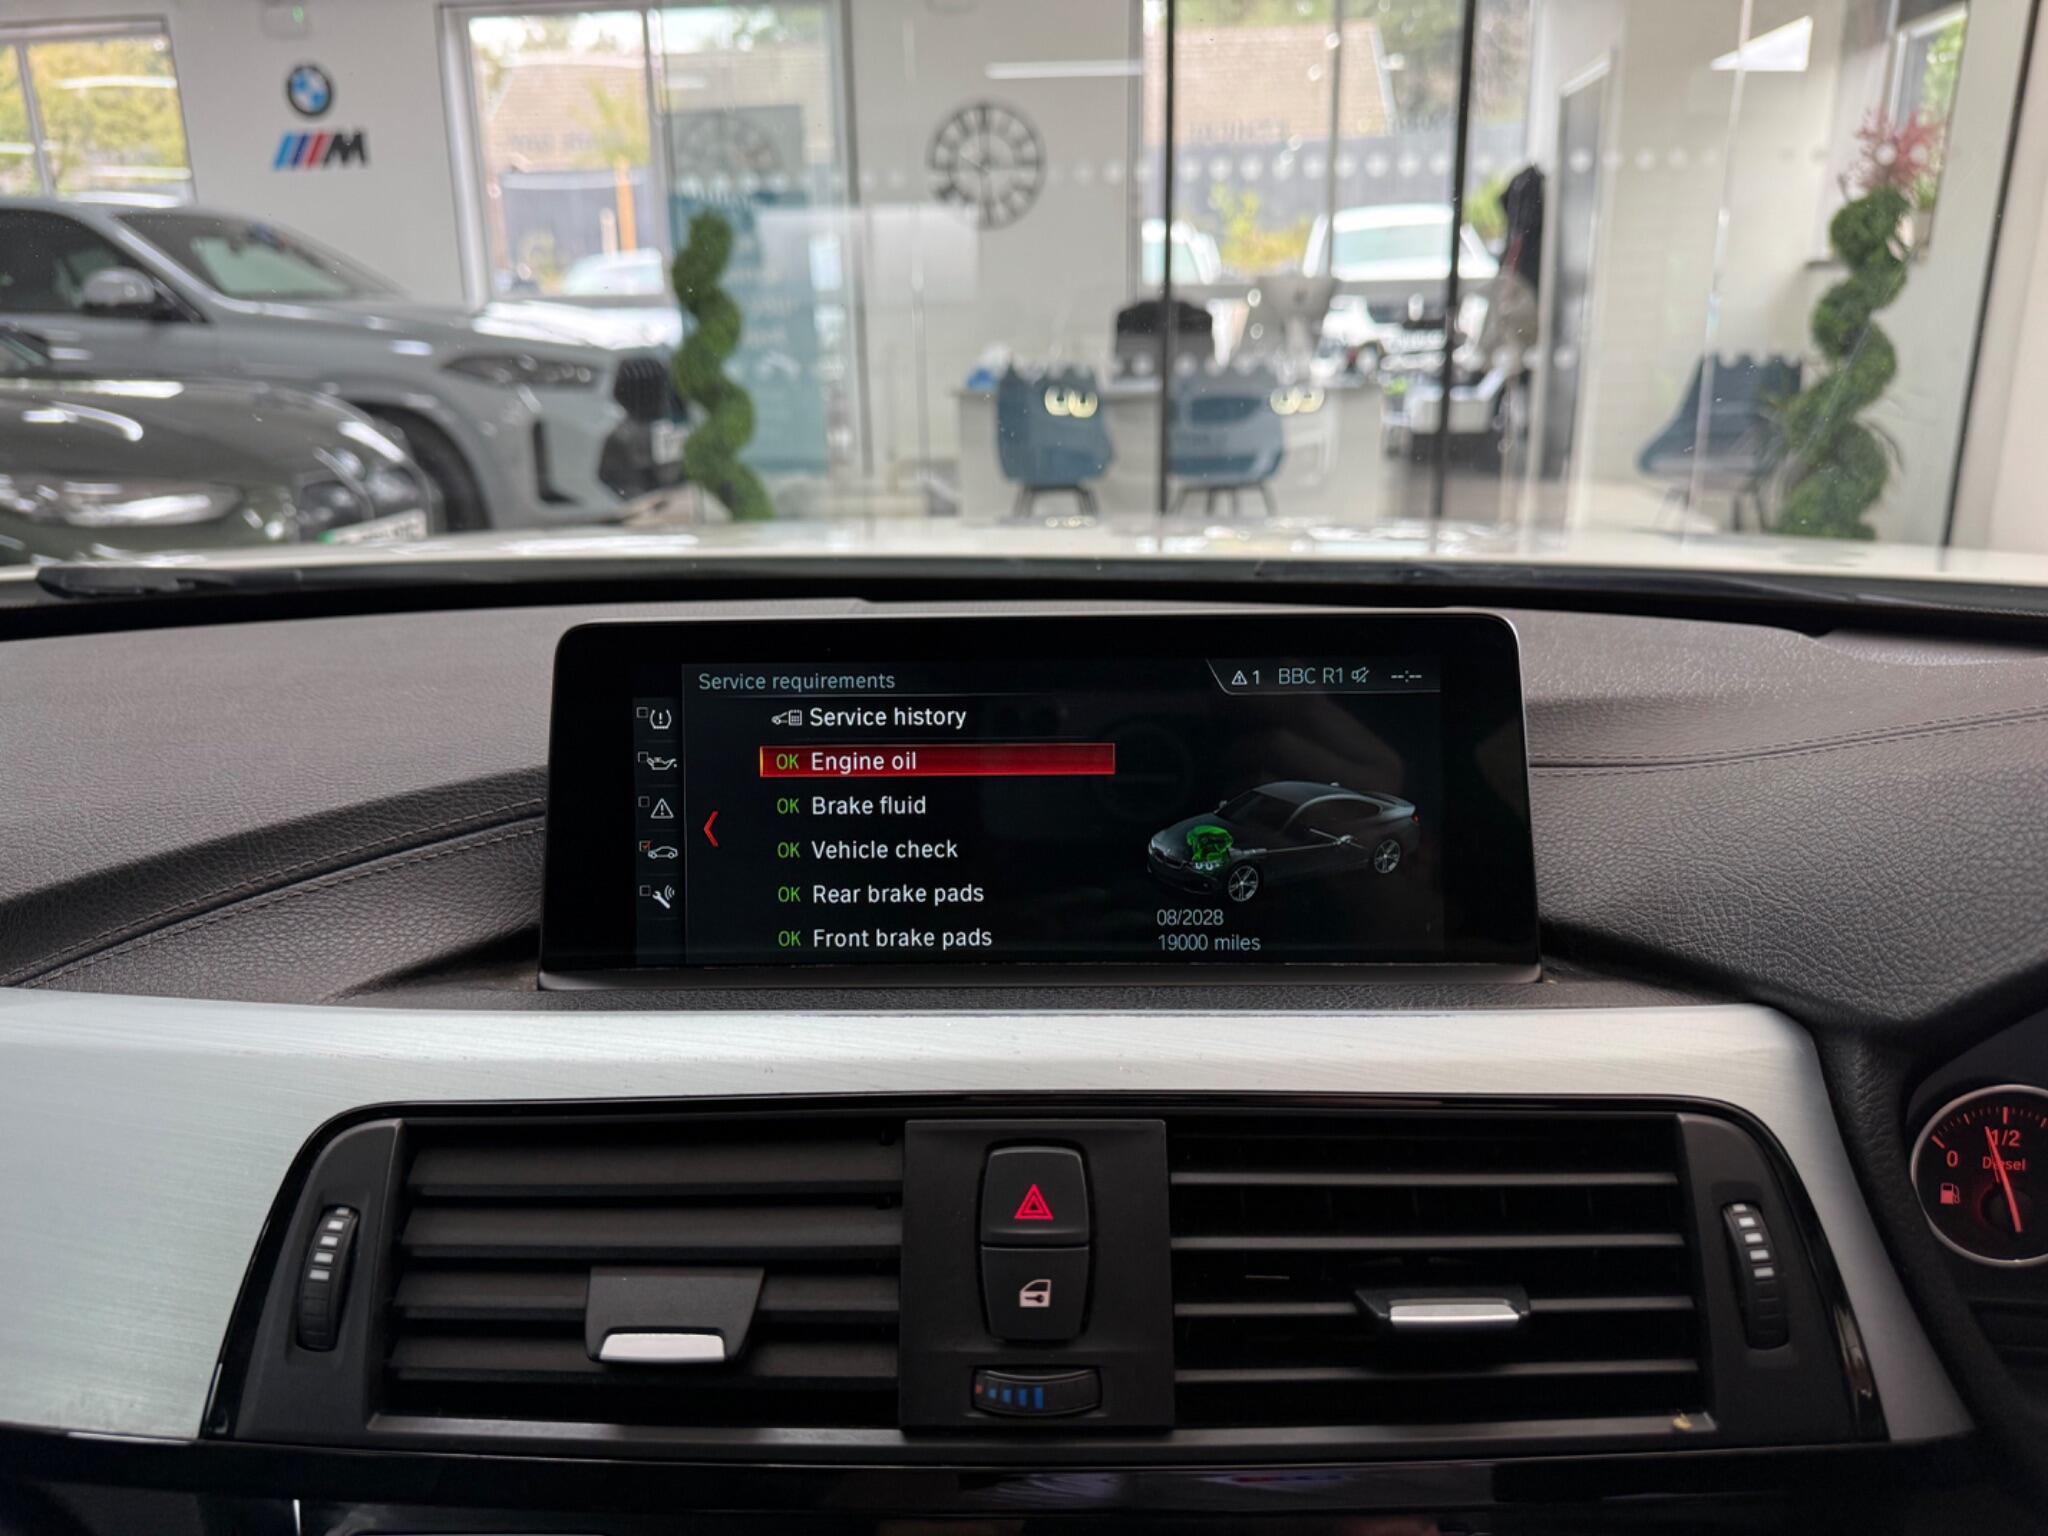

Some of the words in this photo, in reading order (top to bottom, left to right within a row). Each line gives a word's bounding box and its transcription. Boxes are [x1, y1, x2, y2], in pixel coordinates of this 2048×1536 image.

[698, 673, 766, 691] Service
[772, 673, 896, 693] requirements
[1252, 670, 1261, 685] 1
[1278, 667, 1316, 685] BBC
[1323, 667, 1343, 685] R1
[809, 707, 887, 727] Service
[894, 706, 967, 730] history
[776, 754, 799, 770] OK
[811, 751, 885, 775] Engine
[891, 751, 916, 770] oil
[777, 798, 800, 814] OK
[812, 796, 874, 815] Brake
[879, 795, 927, 814] fluid
[778, 842, 800, 858] OK
[811, 840, 889, 860] Vehicle
[895, 839, 958, 859] check
[778, 886, 801, 902] OK
[813, 884, 861, 904] Rear
[868, 884, 927, 903] brake
[934, 883, 984, 907] pads
[1157, 909, 1224, 926] 08/2028
[778, 931, 801, 947] OK
[813, 928, 869, 948] Front
[876, 928, 935, 947] brake
[942, 927, 992, 951] pads
[1158, 934, 1208, 951] 19000
[1214, 934, 1261, 951] miles
[1991, 1128, 2021, 1148] 1/2
[1946, 1150, 1959, 1168] 0
[1982, 1155, 2026, 1171] Dsel
